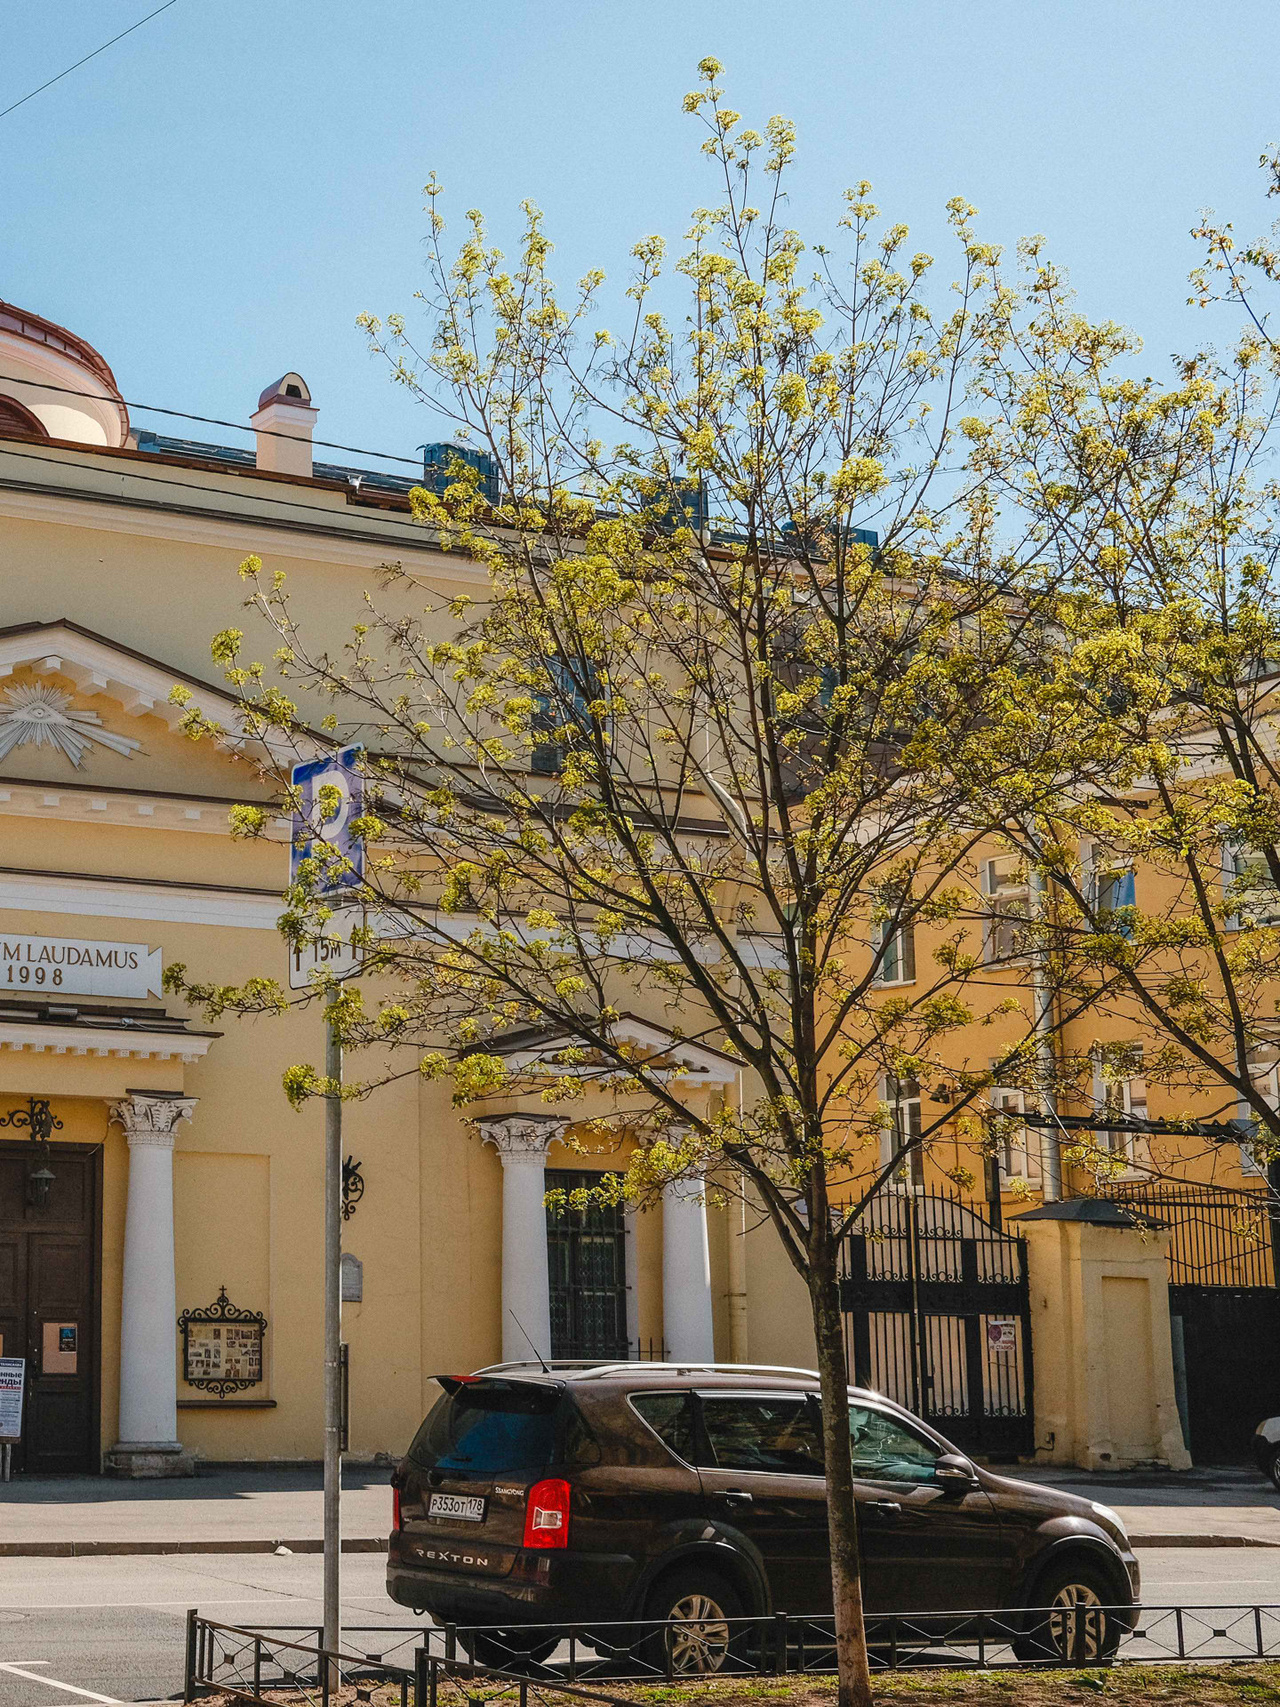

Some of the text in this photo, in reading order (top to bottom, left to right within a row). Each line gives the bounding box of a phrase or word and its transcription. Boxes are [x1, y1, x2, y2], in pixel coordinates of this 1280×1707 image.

[27, 943, 139, 970] LAUDAMUS
[6, 964, 64, 986] 1998
[467, 1498, 483, 1511] 178
[415, 1548, 488, 1567] REXTON
